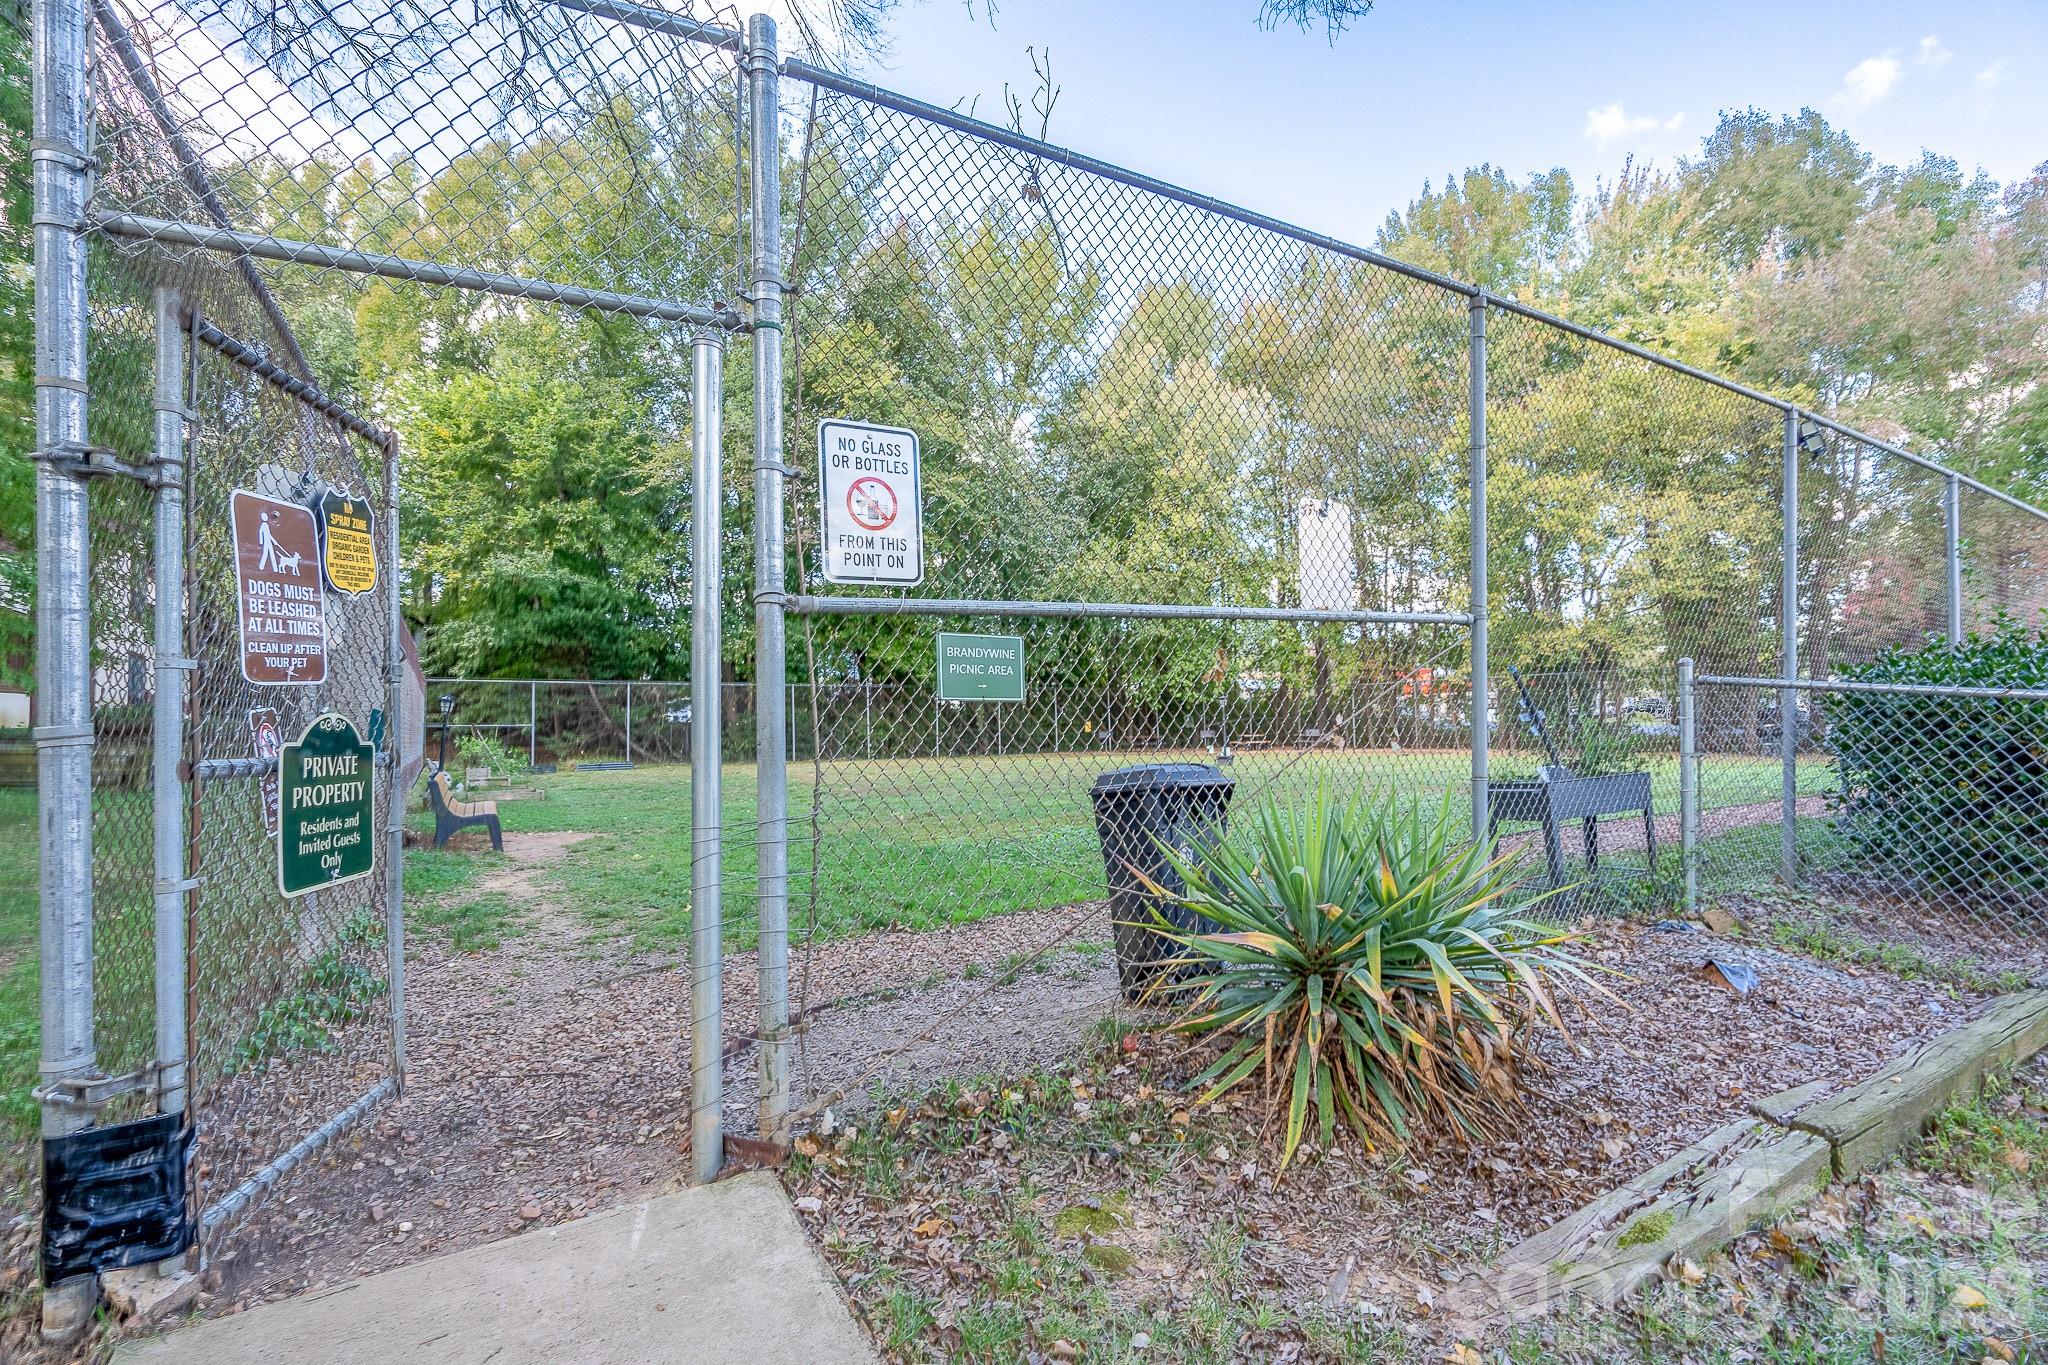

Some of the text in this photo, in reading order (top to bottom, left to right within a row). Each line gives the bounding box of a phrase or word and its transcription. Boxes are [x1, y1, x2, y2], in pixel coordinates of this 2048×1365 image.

[838, 437, 901, 457] NO GLASS
[832, 454, 909, 475] OR BOTTLES
[352, 518, 367, 531] ZONE
[839, 535, 907, 551] FROM THIS
[844, 553, 904, 568] POINT ON
[248, 579, 314, 601] DOGS MUST
[249, 598, 316, 618] BE LEASHED
[248, 617, 320, 636] AT ALL TIMES
[248, 642, 321, 654] CLEAN UP AFTER
[946, 647, 1016, 660] BRANDYWINE
[264, 657, 308, 668] YOUR PET
[949, 664, 1014, 675] PICNIC AREA
[303, 755, 358, 779] PRIVATE
[292, 781, 365, 809] PROPERTY
[300, 812, 360, 836] Residents and
[299, 831, 361, 855] Invited Guests
[321, 851, 343, 869] Only
